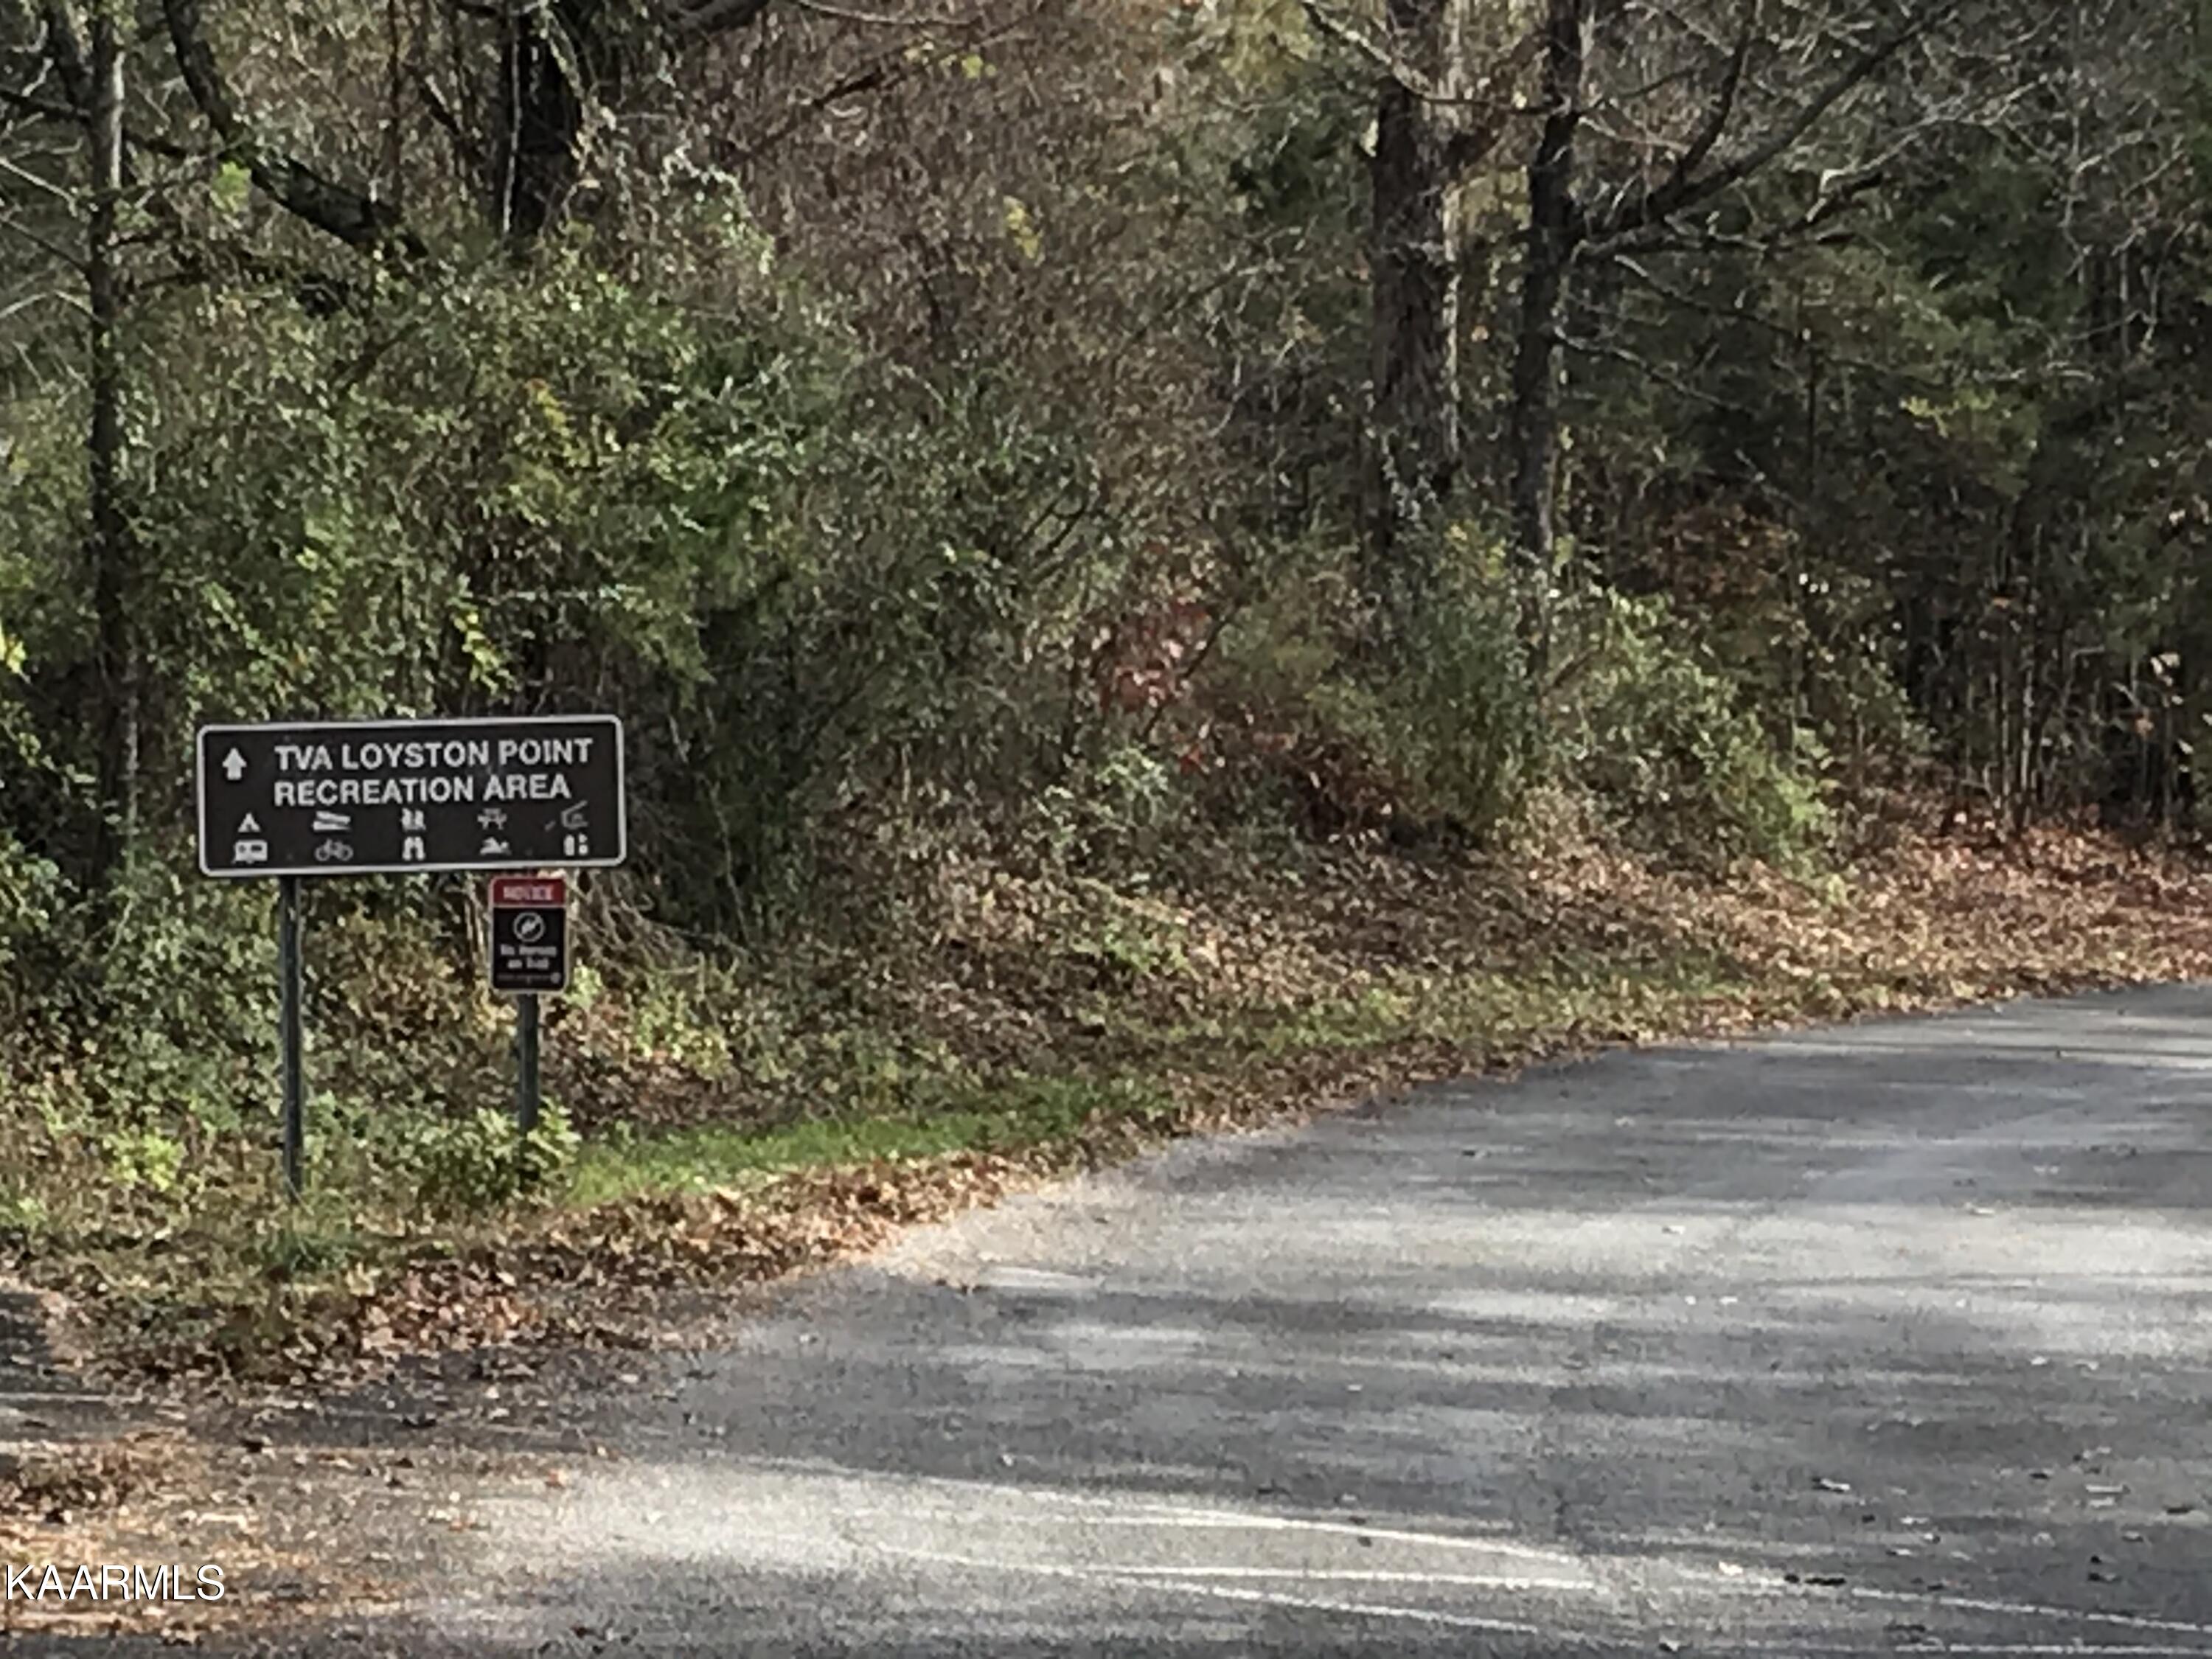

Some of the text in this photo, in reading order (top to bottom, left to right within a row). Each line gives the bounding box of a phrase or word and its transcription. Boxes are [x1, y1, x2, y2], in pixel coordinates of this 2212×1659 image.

[274, 738, 593, 771] TVA LOYSTON POINT
[274, 773, 571, 807] RECREATION AREA
